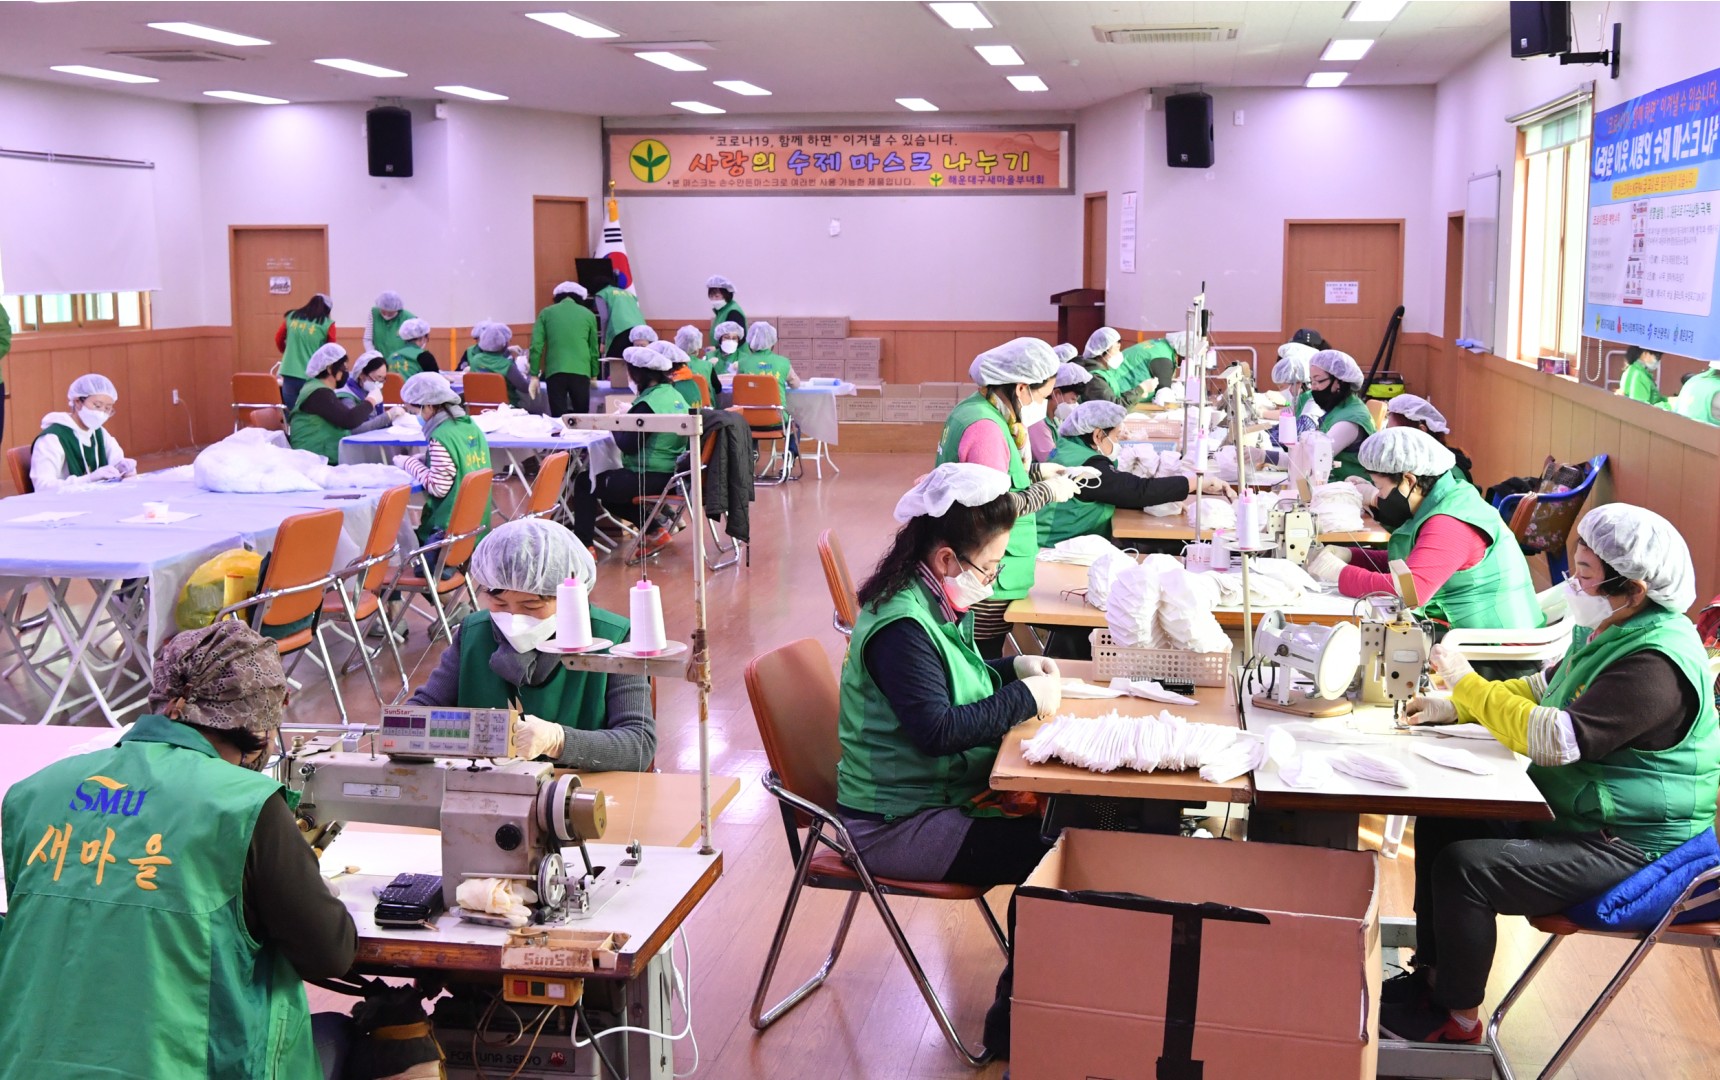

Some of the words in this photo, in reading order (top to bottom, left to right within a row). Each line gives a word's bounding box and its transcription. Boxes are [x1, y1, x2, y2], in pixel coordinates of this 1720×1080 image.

[779, 135, 803, 147] 함께
[843, 134, 881, 147] 이겨낼
[885, 134, 897, 147] 수
[901, 133, 958, 147] 있습니다.
[1629, 131, 1653, 170] 사랑의
[1653, 126, 1672, 165] 수제
[1672, 119, 1701, 161] 마스크
[688, 149, 776, 177] 사랑의
[787, 149, 843, 176] 수제
[850, 151, 932, 172] 마스크
[942, 150, 1030, 175] 나누기
[384, 708, 411, 716] SunStar
[69, 781, 151, 816] SMU
[450, 1050, 503, 1063] FORUNA
